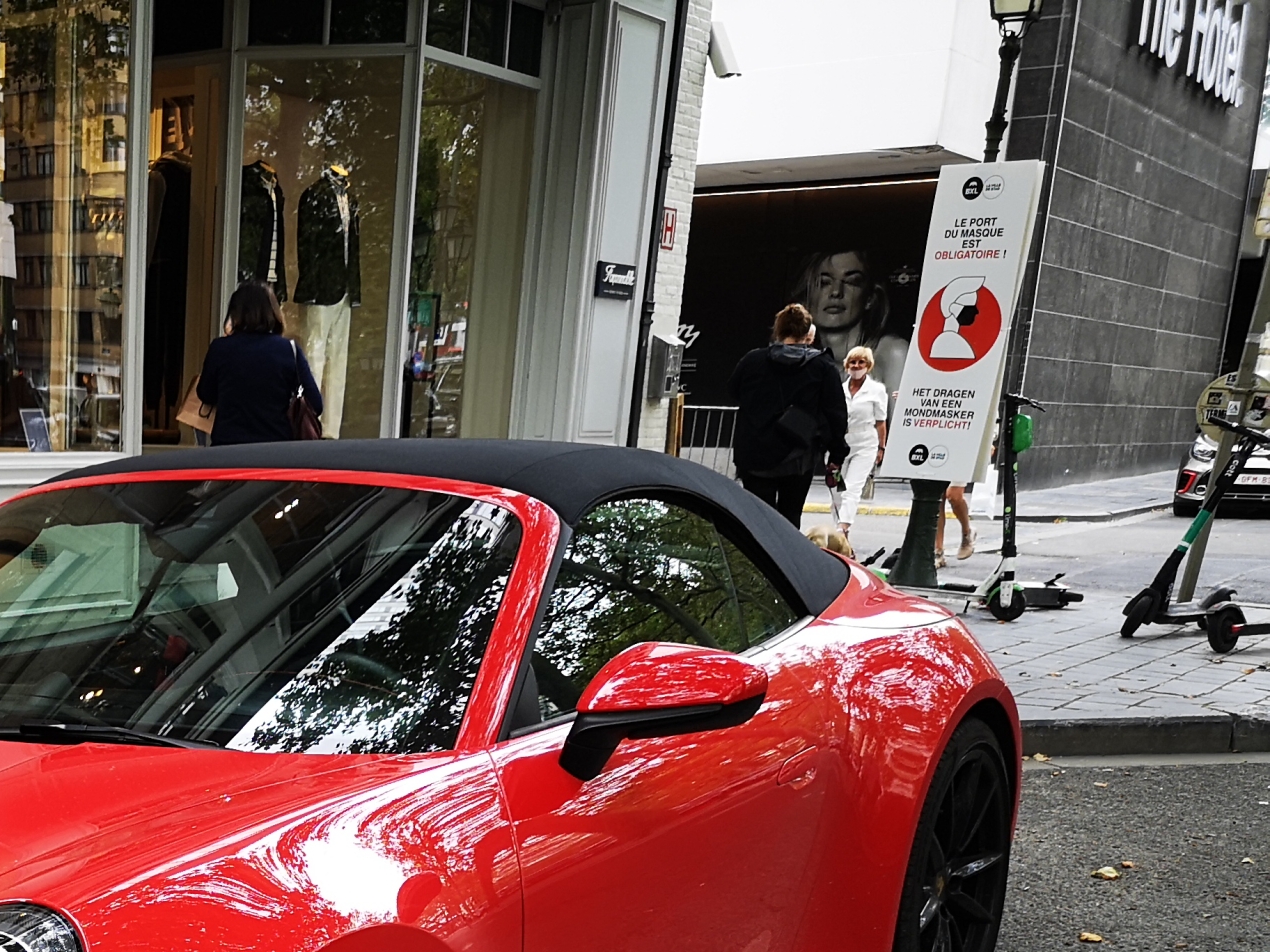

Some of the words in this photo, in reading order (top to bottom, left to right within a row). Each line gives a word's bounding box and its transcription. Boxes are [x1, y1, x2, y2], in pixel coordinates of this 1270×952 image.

[955, 218, 967, 227] LE
[970, 217, 998, 227] PORT
[944, 229, 959, 239] DU
[960, 228, 1004, 238] MASQUE
[962, 239, 982, 249] EST
[934, 250, 1000, 260] OBLIGATOIRE
[1003, 249, 1007, 259] !
[912, 388, 931, 397] HET
[933, 389, 975, 399] DRAGEN
[920, 399, 940, 408] VAN
[941, 399, 962, 409] EEN
[904, 408, 975, 420] MONDMASKER
[902, 418, 912, 427] IS
[913, 419, 971, 430] VERPLICHT!
